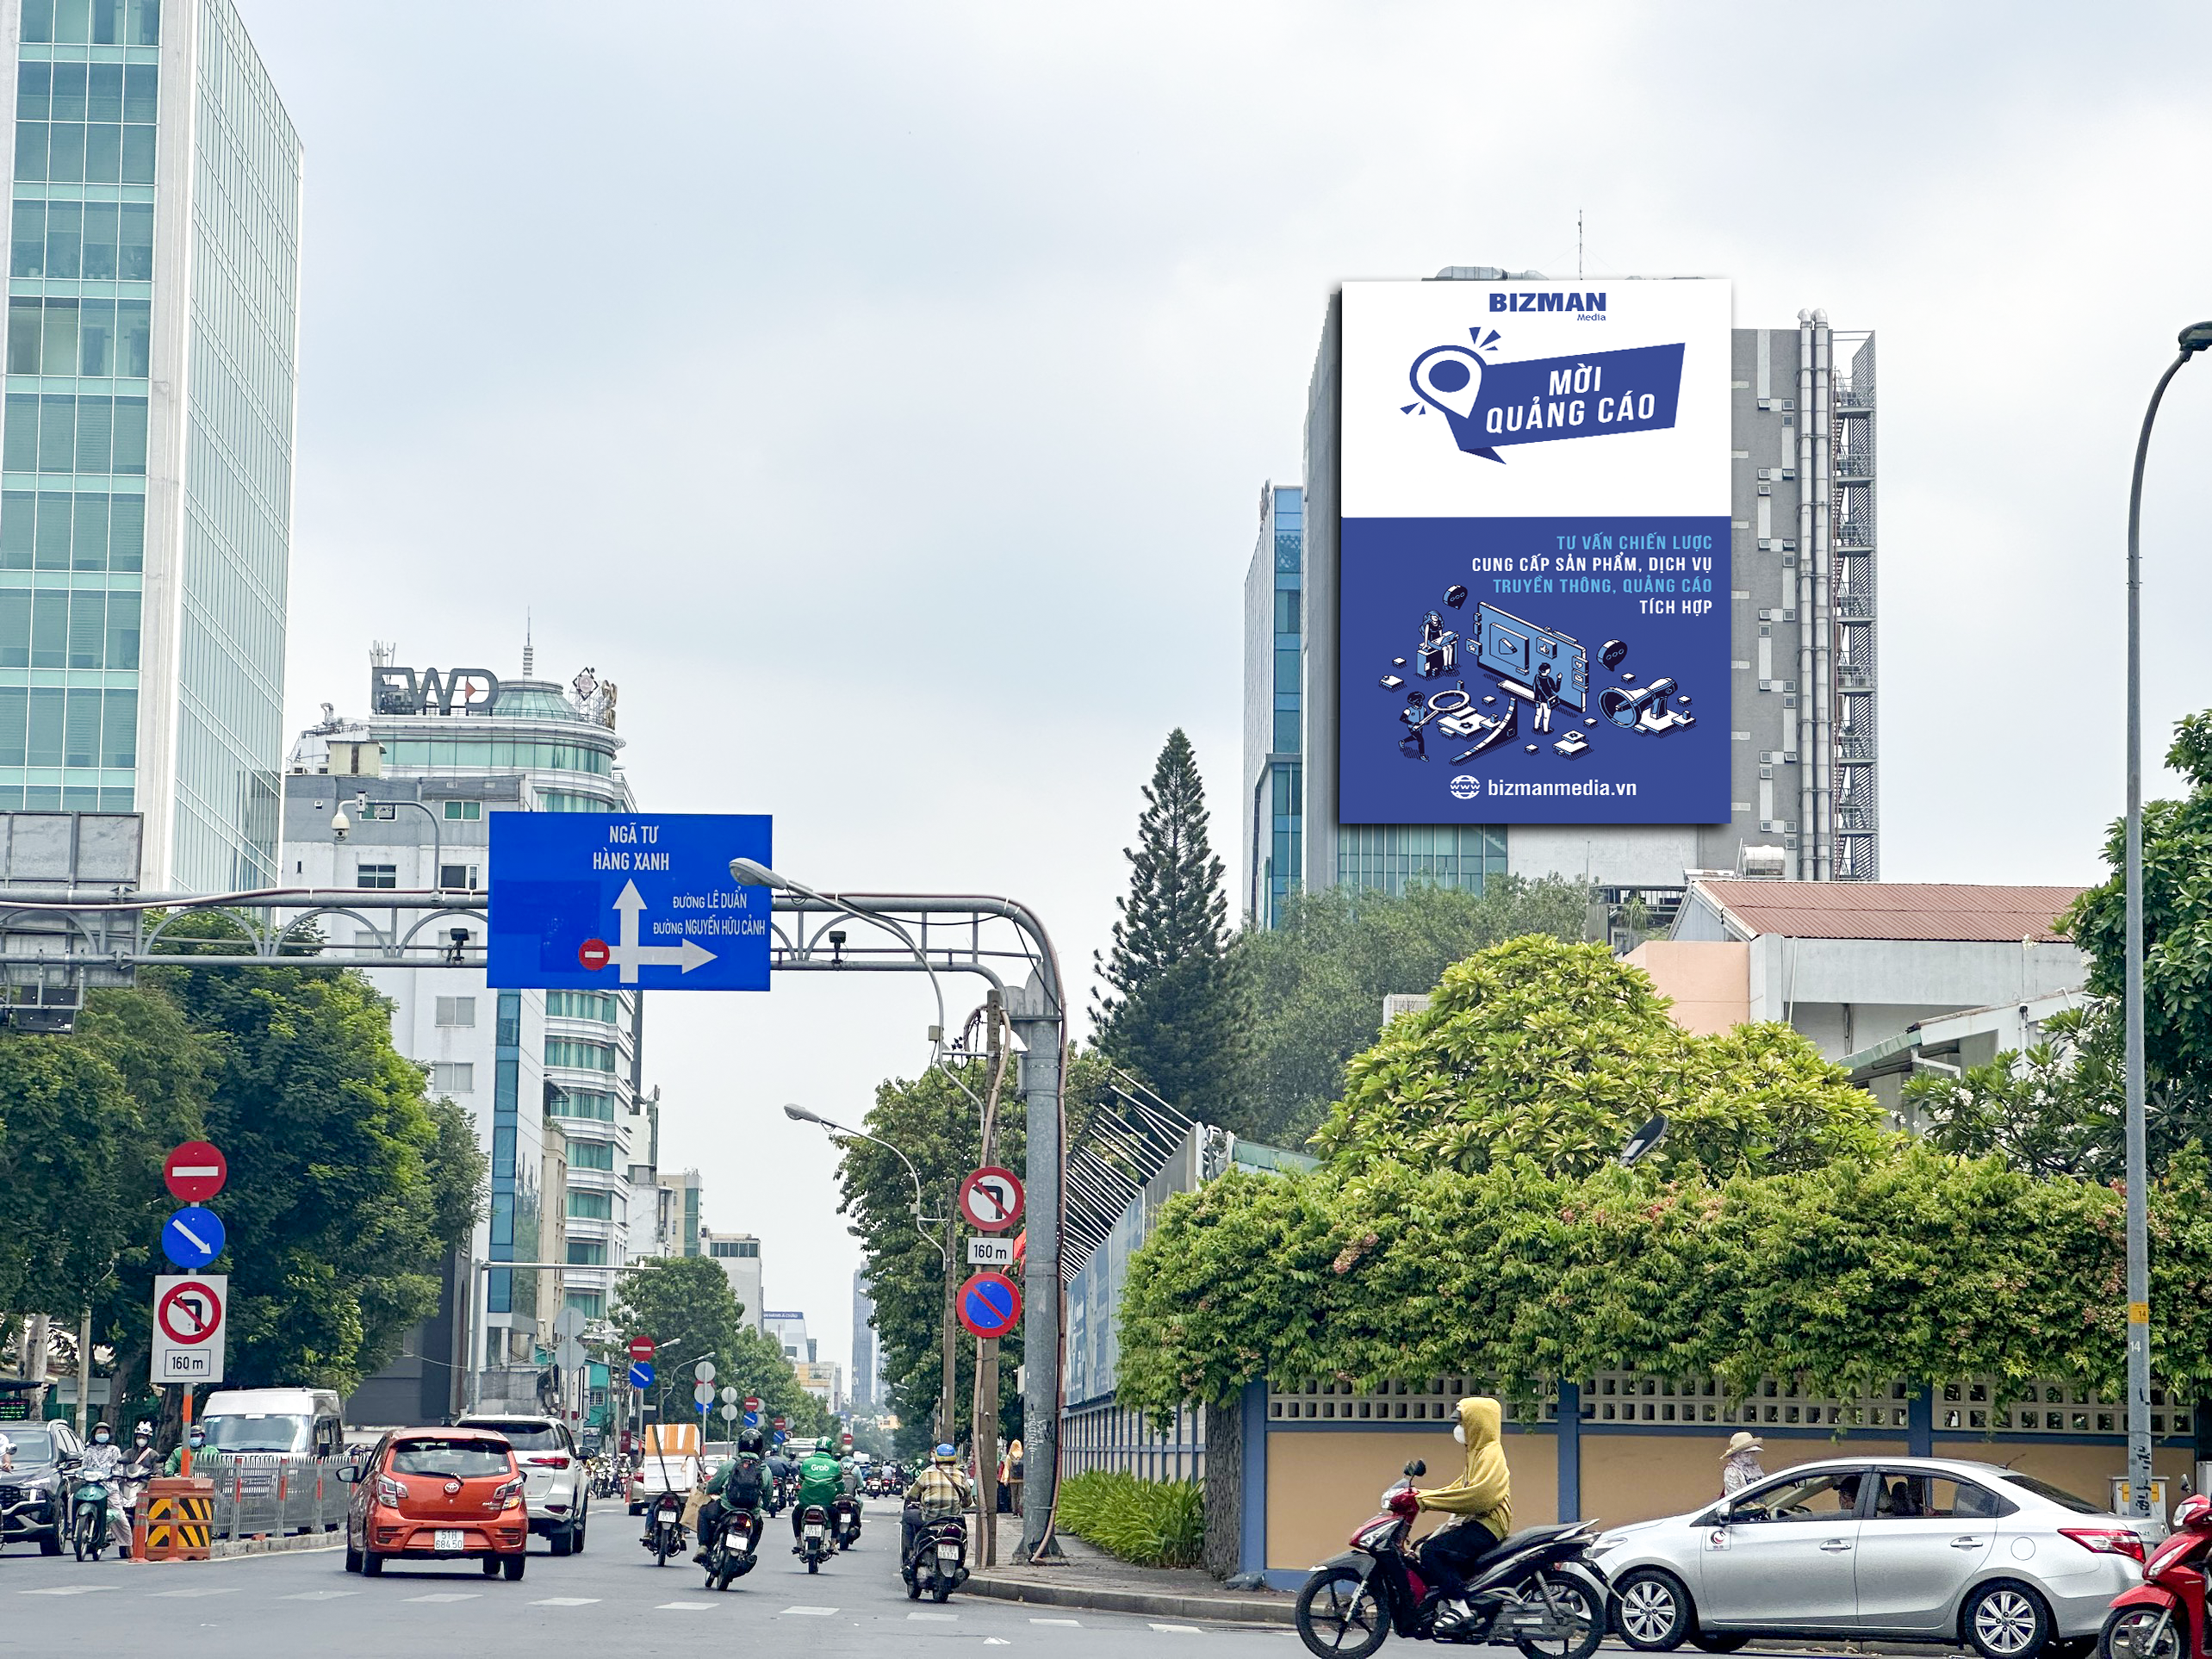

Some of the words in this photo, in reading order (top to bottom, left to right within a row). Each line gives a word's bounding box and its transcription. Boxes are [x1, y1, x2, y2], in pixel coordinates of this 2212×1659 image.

[1489, 293, 1606, 312] BIZMAN
[1549, 363, 1602, 396] MỜI
[1486, 395, 1585, 434] QUẢNG
[1598, 390, 1656, 424] CÁO
[1556, 535, 1576, 550] TƯ
[1581, 531, 1612, 550] VẤN
[1619, 531, 1666, 550] CHIẾN
[1673, 535, 1712, 552] LƯỢC
[1472, 557, 1513, 572] CUNG
[1519, 553, 1550, 572] CẤP
[1556, 553, 1586, 572] SẢN
[1593, 551, 1643, 573] PHẨM,
[1649, 557, 1686, 574] DỊCH
[1692, 557, 1712, 574] VỤ
[1493, 575, 1553, 593] TRUYỀN
[1560, 576, 1617, 594] THÔNG,
[1623, 575, 1675, 593] QUẢNG
[1681, 575, 1712, 593] CÁO
[1639, 598, 1675, 614] TÍCH
[1682, 600, 1712, 617] HỢP
[371, 667, 499, 711] FWD
[1488, 780, 1637, 796] bizmanmedia.vn
[609, 822, 637, 844] NGÃ
[640, 824, 660, 844] TƯ
[593, 847, 630, 871] HÀNG
[633, 852, 669, 871] XANH
[673, 892, 705, 909] ĐƯỜNG
[707, 889, 719, 909] LÊ
[721, 885, 747, 909] DUẨN
[653, 918, 683, 935] ĐƯỜNG
[685, 914, 720, 935] NGUYỄN
[721, 916, 741, 935] HỮU
[742, 914, 766, 935] CẢNH
[974, 1245, 992, 1258] 160
[996, 1249, 1007, 1259] m
[2130, 1340, 2141, 1352] 14
[172, 1357, 190, 1370] 160
[192, 1360, 203, 1370] m
[811, 1463, 830, 1472] Grab
[441, 1531, 457, 1540] 51H
